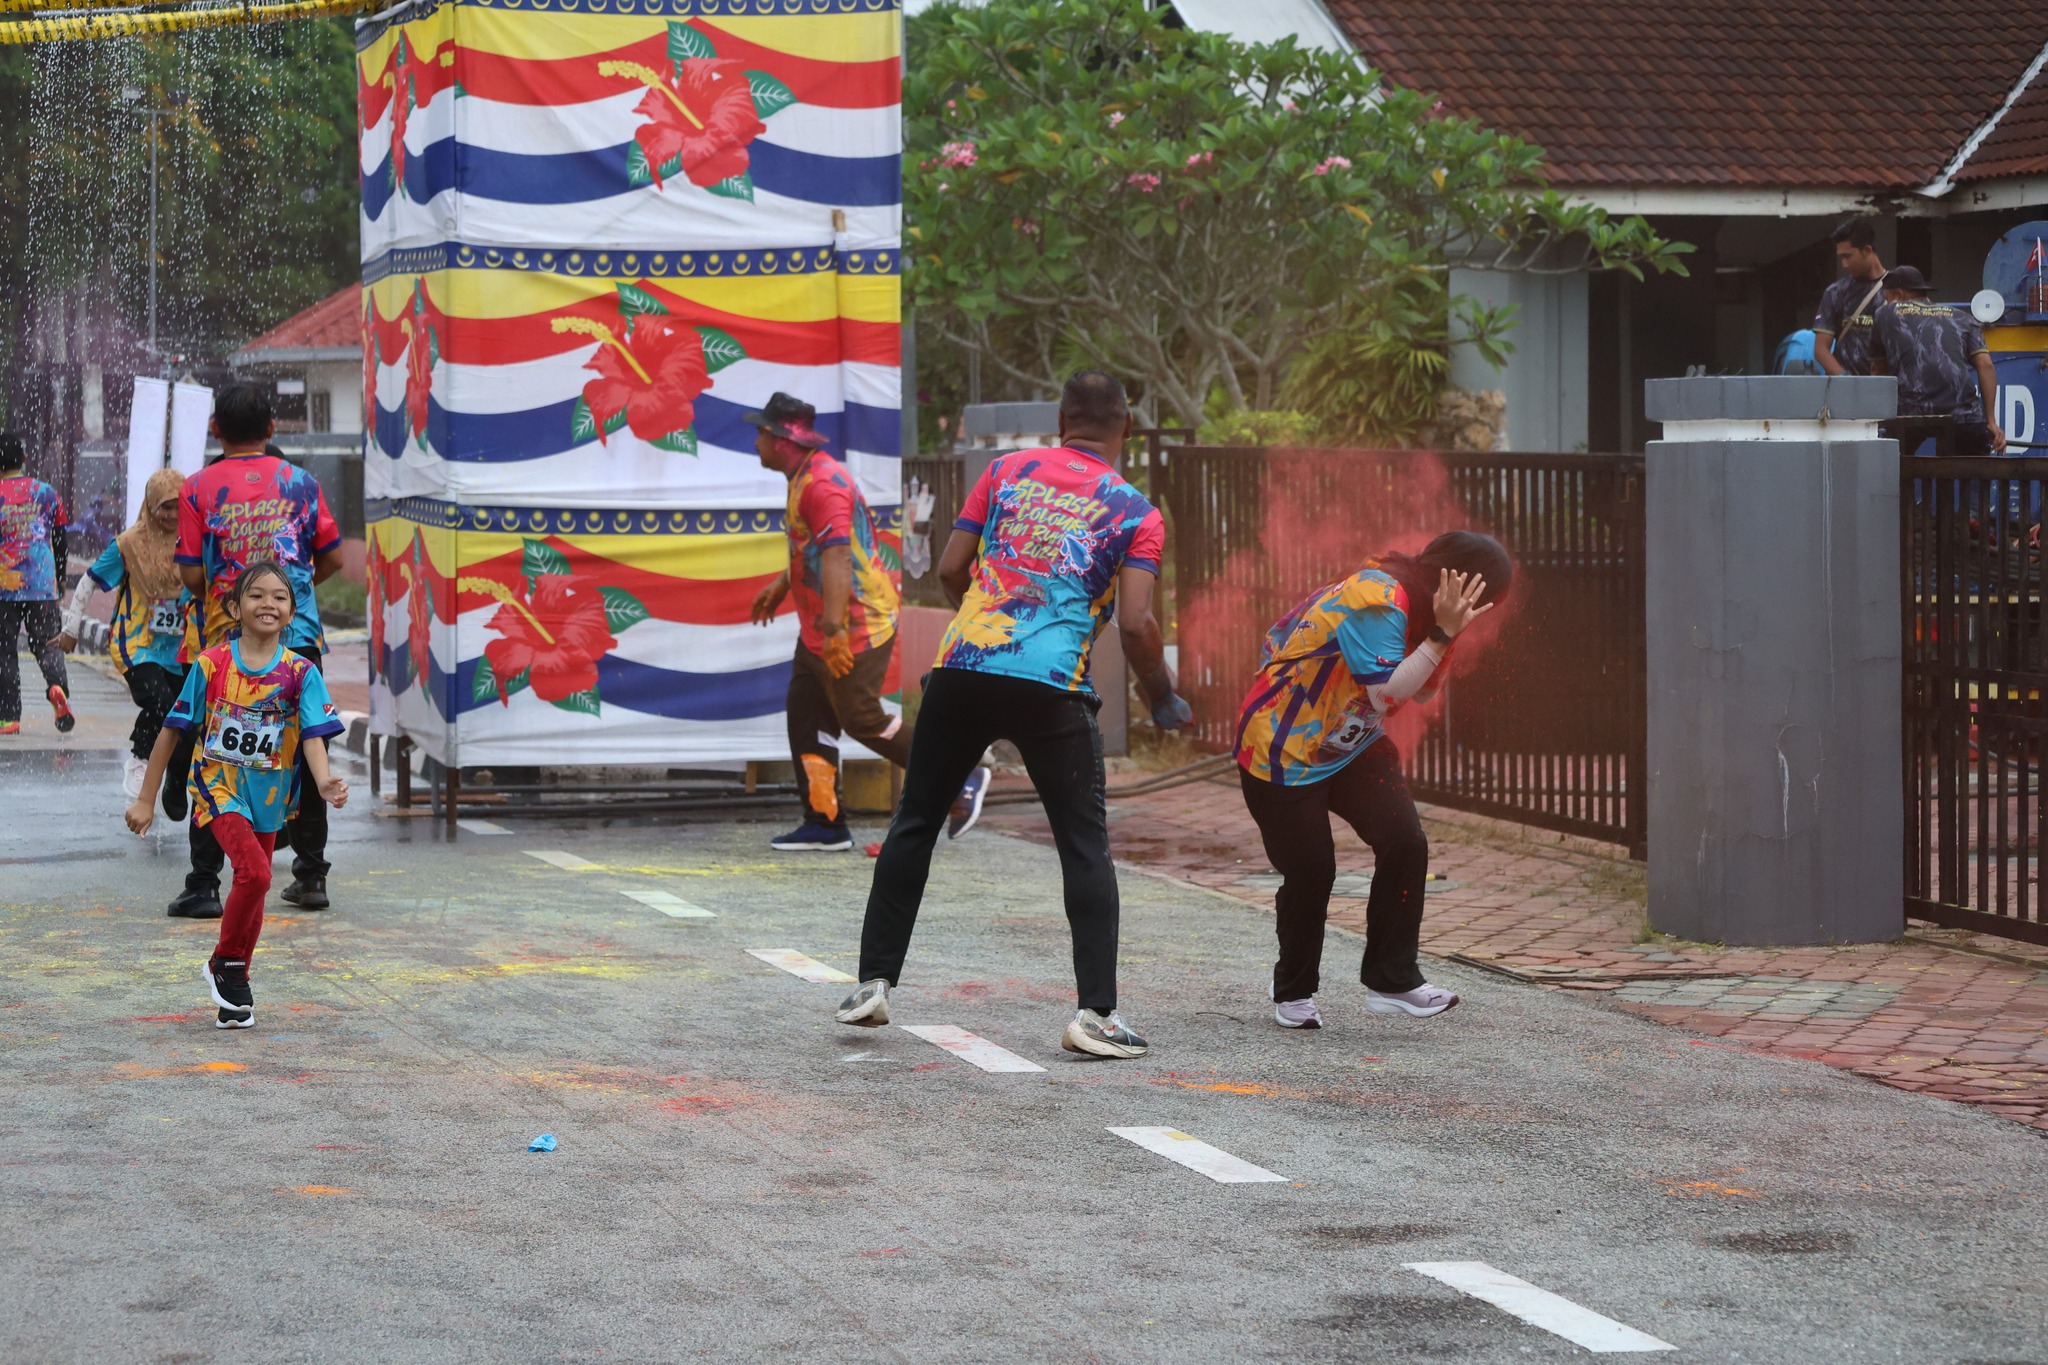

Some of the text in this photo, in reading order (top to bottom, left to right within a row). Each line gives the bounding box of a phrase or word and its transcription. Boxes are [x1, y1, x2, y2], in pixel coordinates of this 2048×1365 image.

[220, 499, 295, 524] SPLASH
[1012, 478, 1109, 524] SPLASH
[230, 518, 289, 540] COLOUR
[1016, 502, 1089, 536] COLOUR
[1020, 541, 1060, 563] 2024
[156, 612, 183, 628] 297
[222, 727, 274, 757] 684
